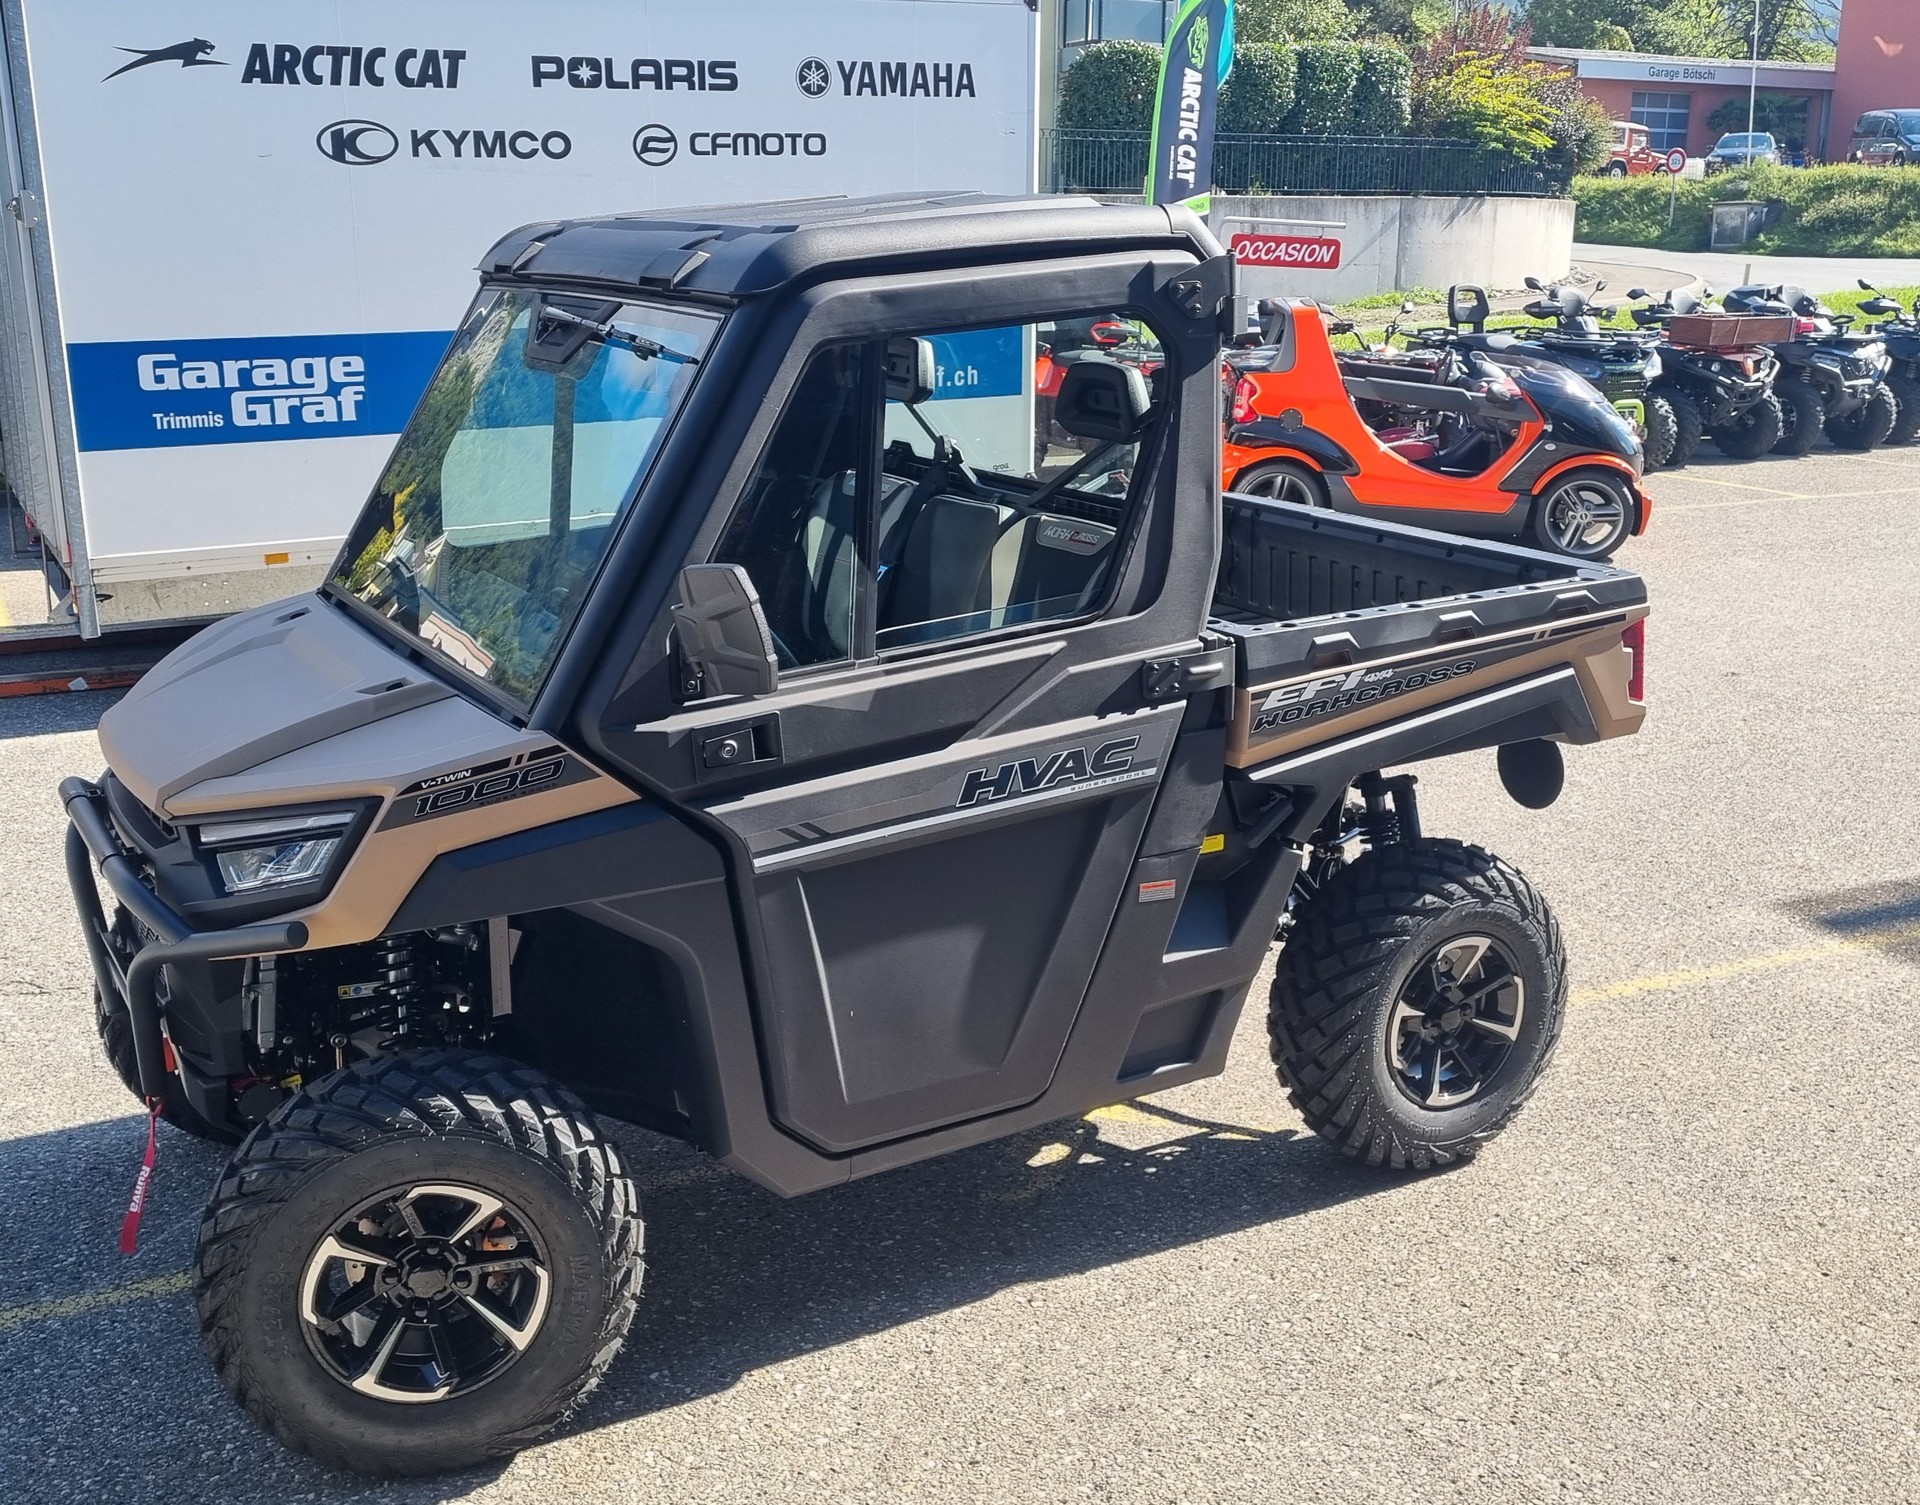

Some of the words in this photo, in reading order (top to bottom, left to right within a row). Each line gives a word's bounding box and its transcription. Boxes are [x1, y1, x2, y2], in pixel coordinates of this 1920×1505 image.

[241, 43, 386, 87] ARCTIC
[395, 48, 466, 89] CAT
[531, 55, 738, 91] POLARIS
[836, 60, 976, 97] YAMAHA
[1648, 66, 1680, 80] Garage
[1682, 67, 1716, 80] Bötschi
[1178, 67, 1203, 142] ARCTIC
[409, 129, 572, 160] KYMCO
[689, 132, 827, 156] CFMOTO
[1176, 144, 1197, 184] CAT
[1235, 240, 1336, 263] OCCASION
[137, 353, 365, 395] Garage
[937, 366, 978, 387] f.ch
[153, 411, 224, 430] Trimmis
[231, 386, 366, 427] Graf
[1260, 669, 1367, 712] EFI
[414, 757, 565, 817] 1000
[420, 769, 472, 789] V-TWIN
[956, 734, 1140, 808] HVAC
[129, 1165, 151, 1213] Runva
